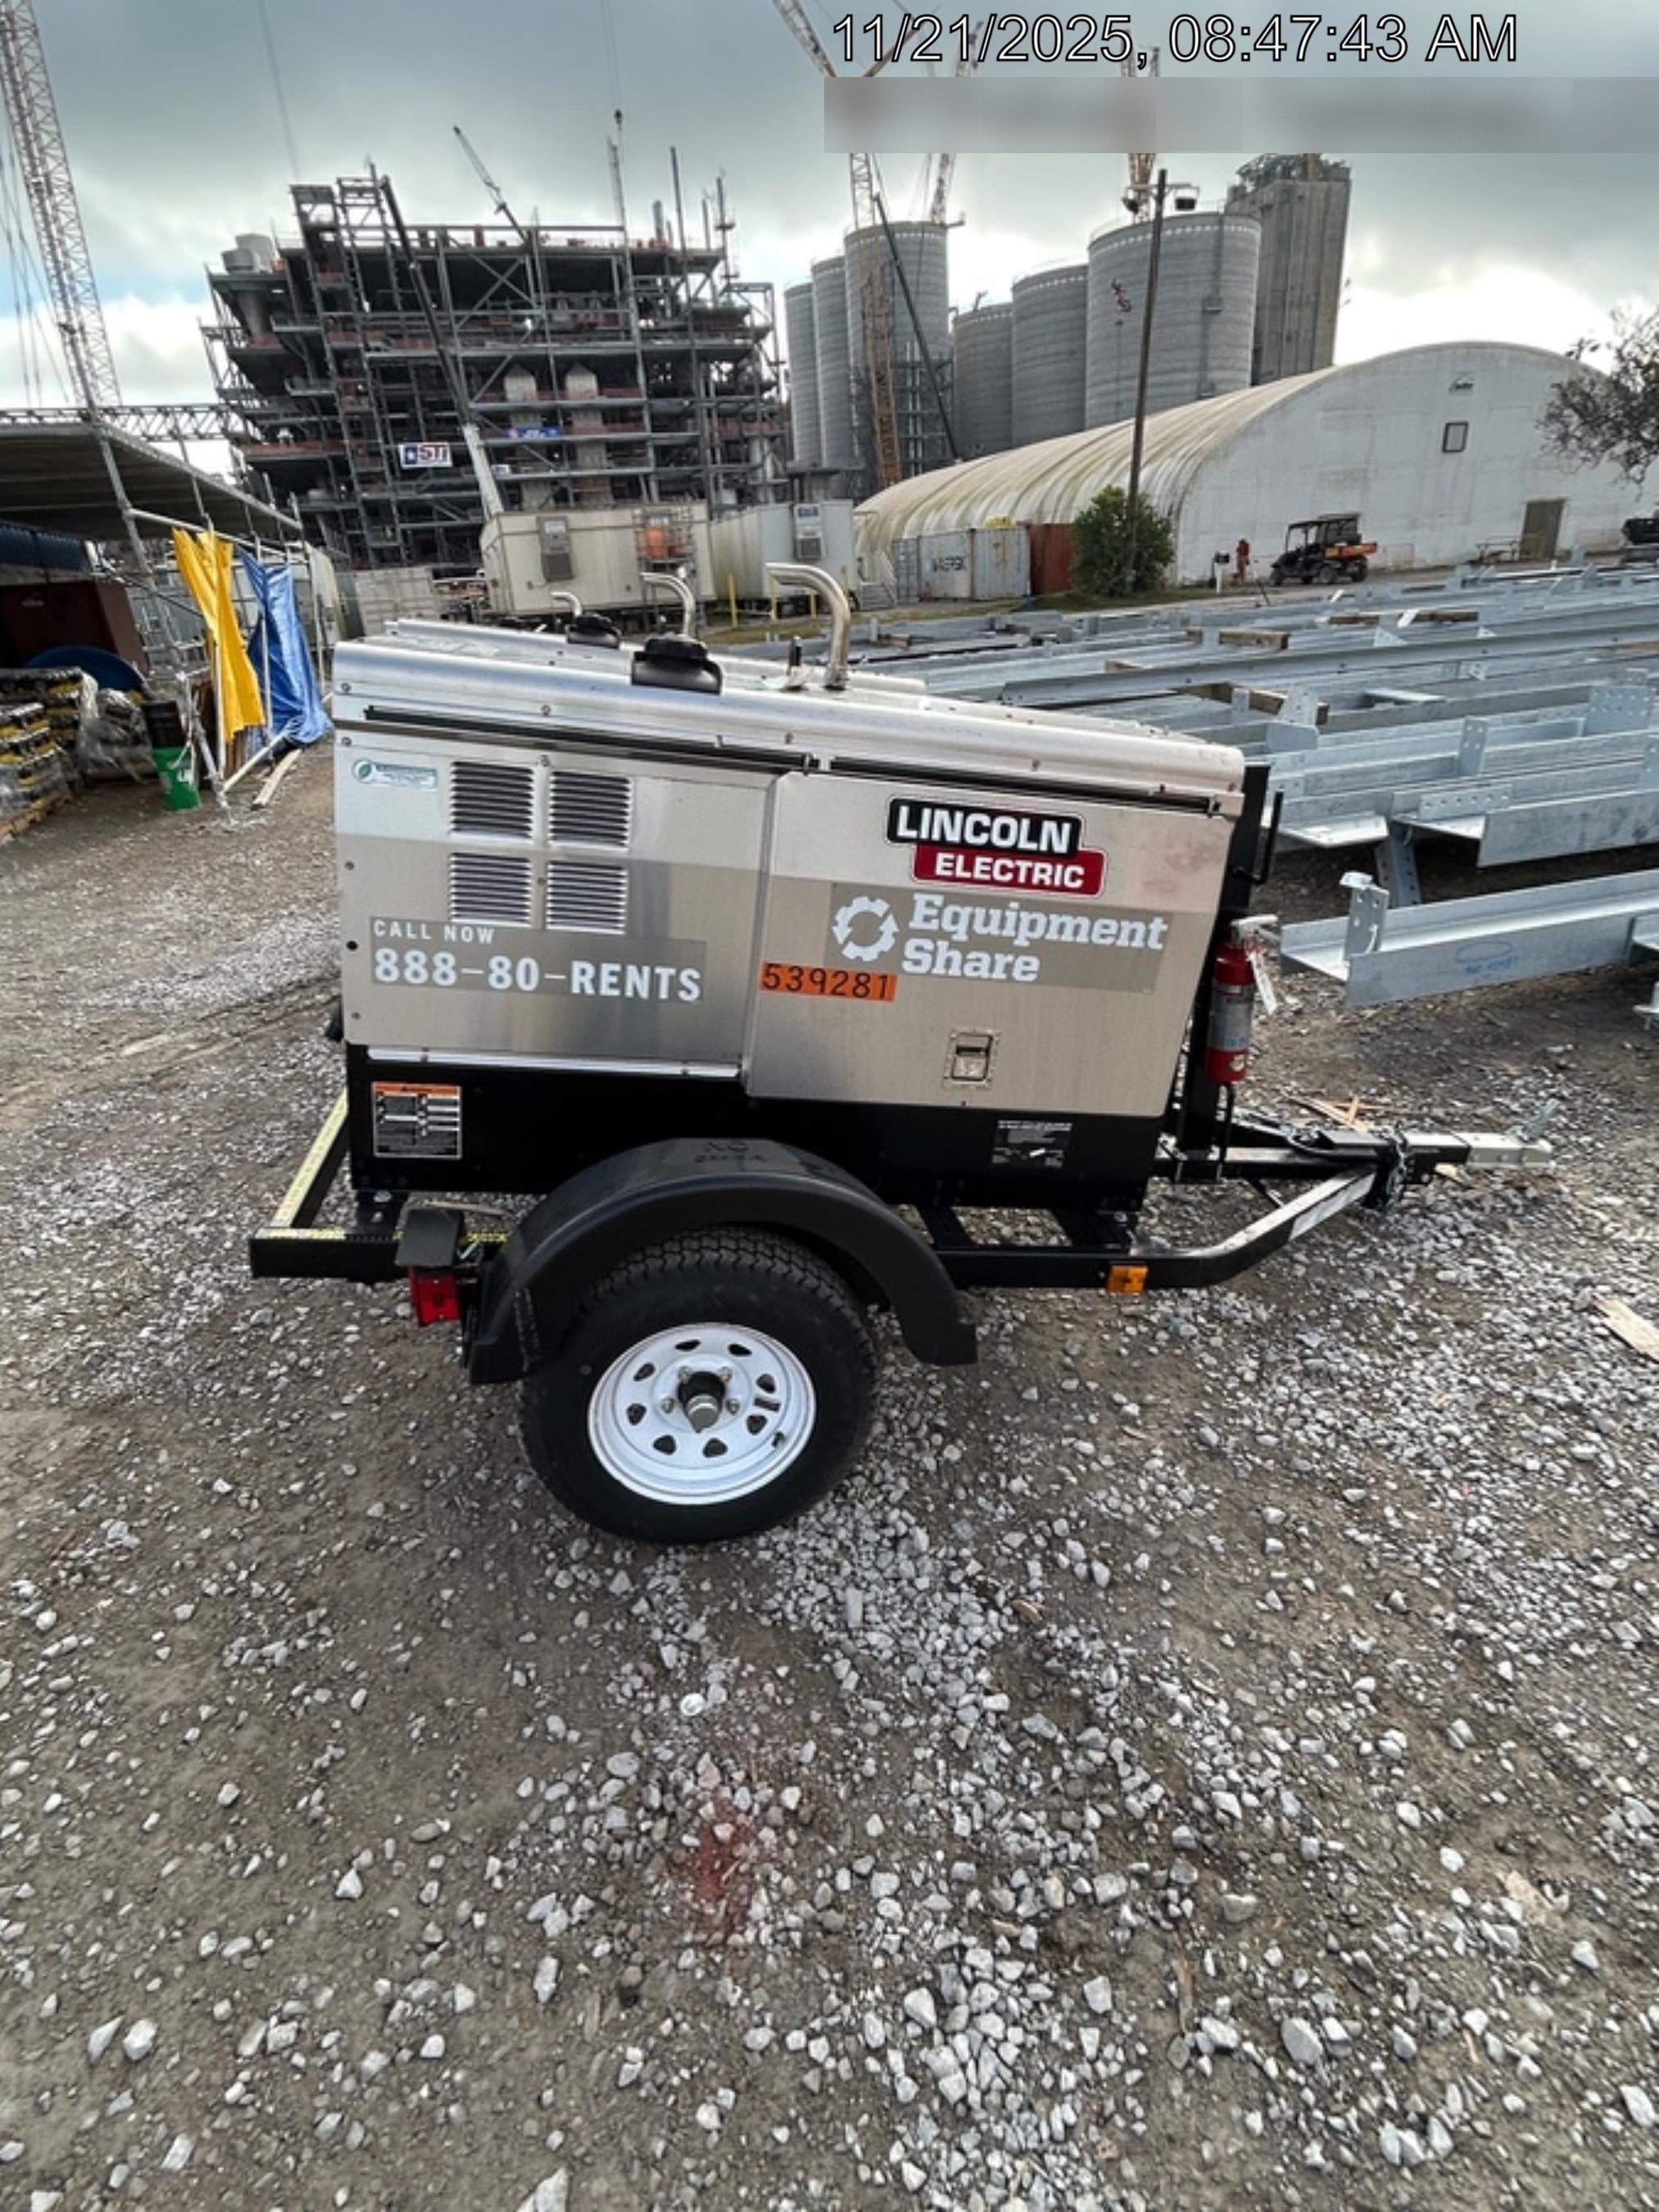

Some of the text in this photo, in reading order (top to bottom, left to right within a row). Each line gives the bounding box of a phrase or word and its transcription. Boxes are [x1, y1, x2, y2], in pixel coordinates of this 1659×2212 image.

[896, 805, 1072, 853] LINCOLN
[935, 853, 1086, 889] ELECTRIC
[373, 920, 496, 945] CALL NOW
[909, 894, 1168, 950] Equipment
[374, 948, 702, 1002] 888-80-RENTS
[762, 962, 890, 1000] 539281
[902, 937, 1040, 982] Share
